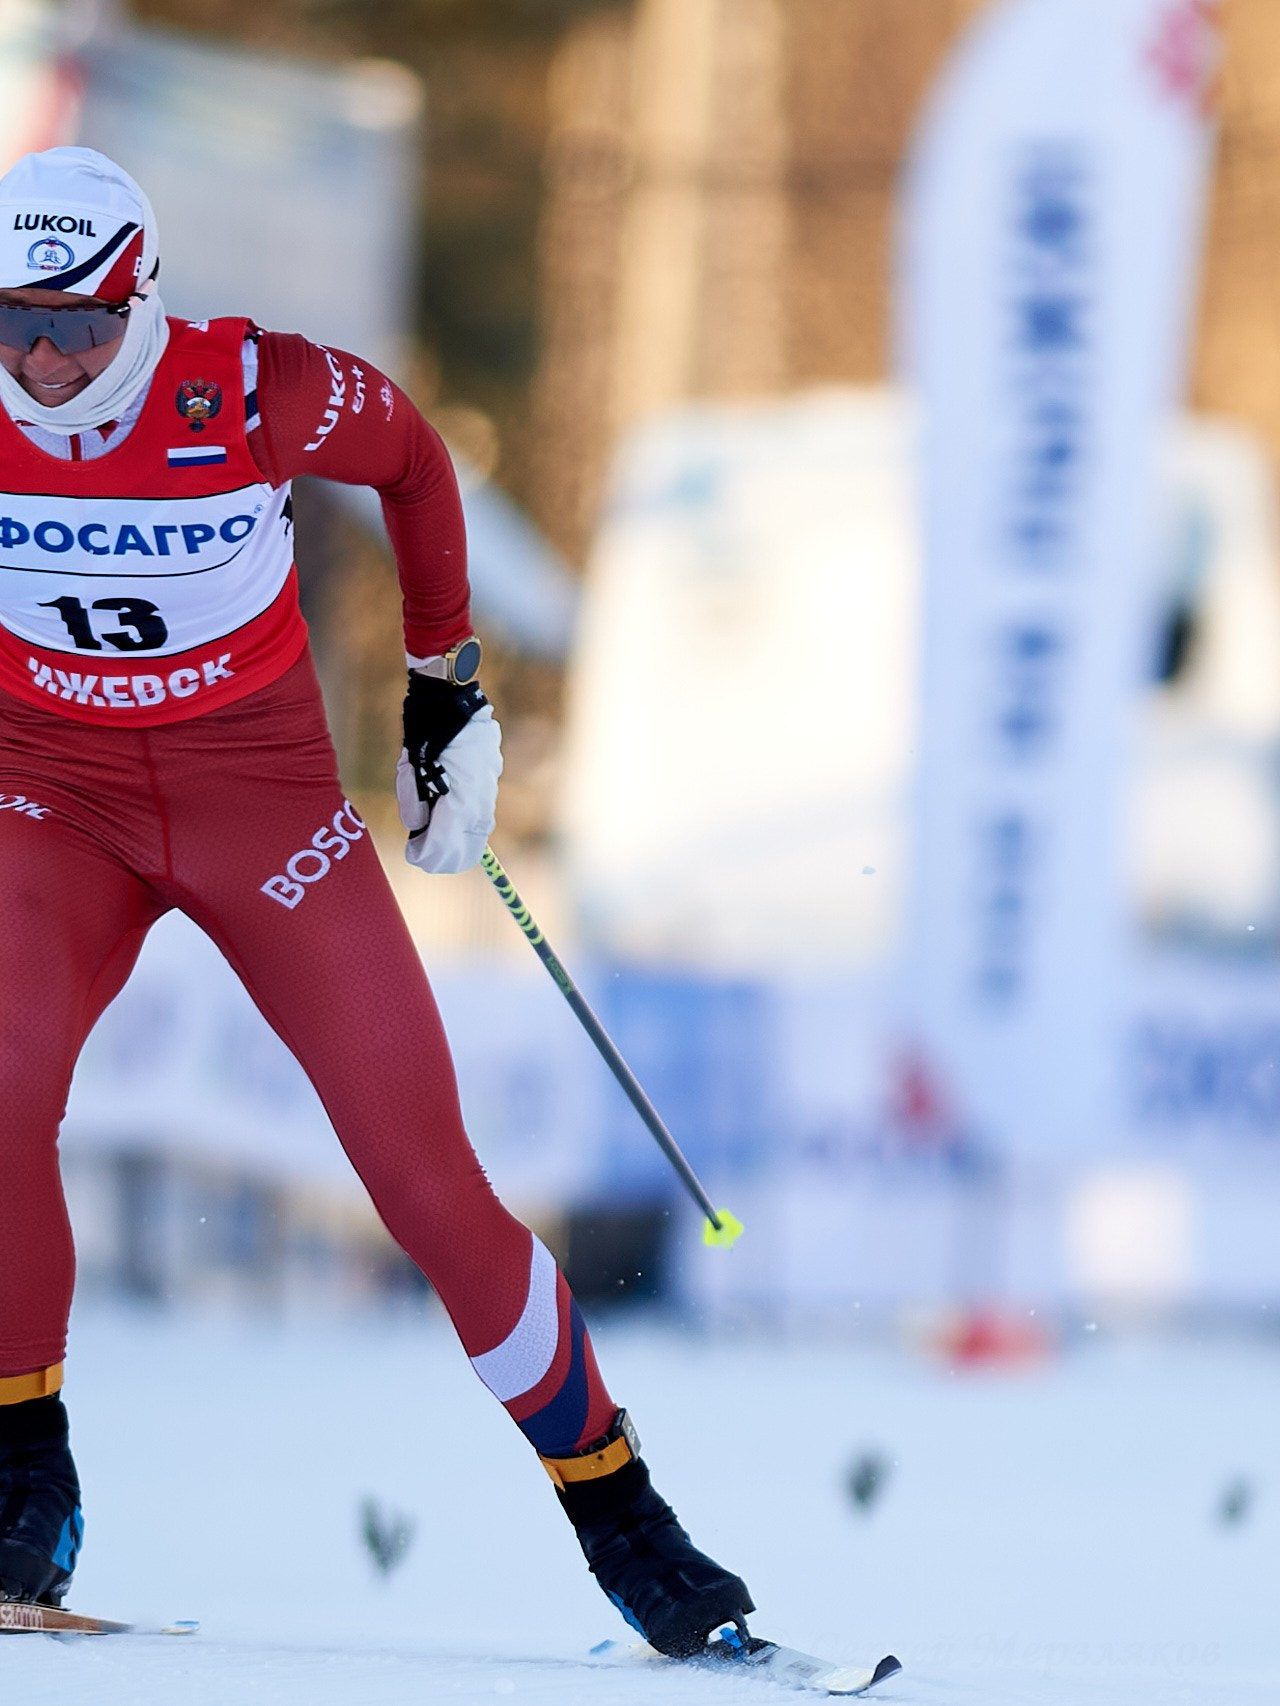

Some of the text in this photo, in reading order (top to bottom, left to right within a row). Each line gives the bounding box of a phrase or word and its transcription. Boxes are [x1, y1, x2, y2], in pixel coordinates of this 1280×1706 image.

[13, 213, 96, 238] LUKOIL
[303, 344, 346, 452] LUKO
[37, 595, 169, 651] 13
[28, 652, 236, 708] ИЖЕВСК
